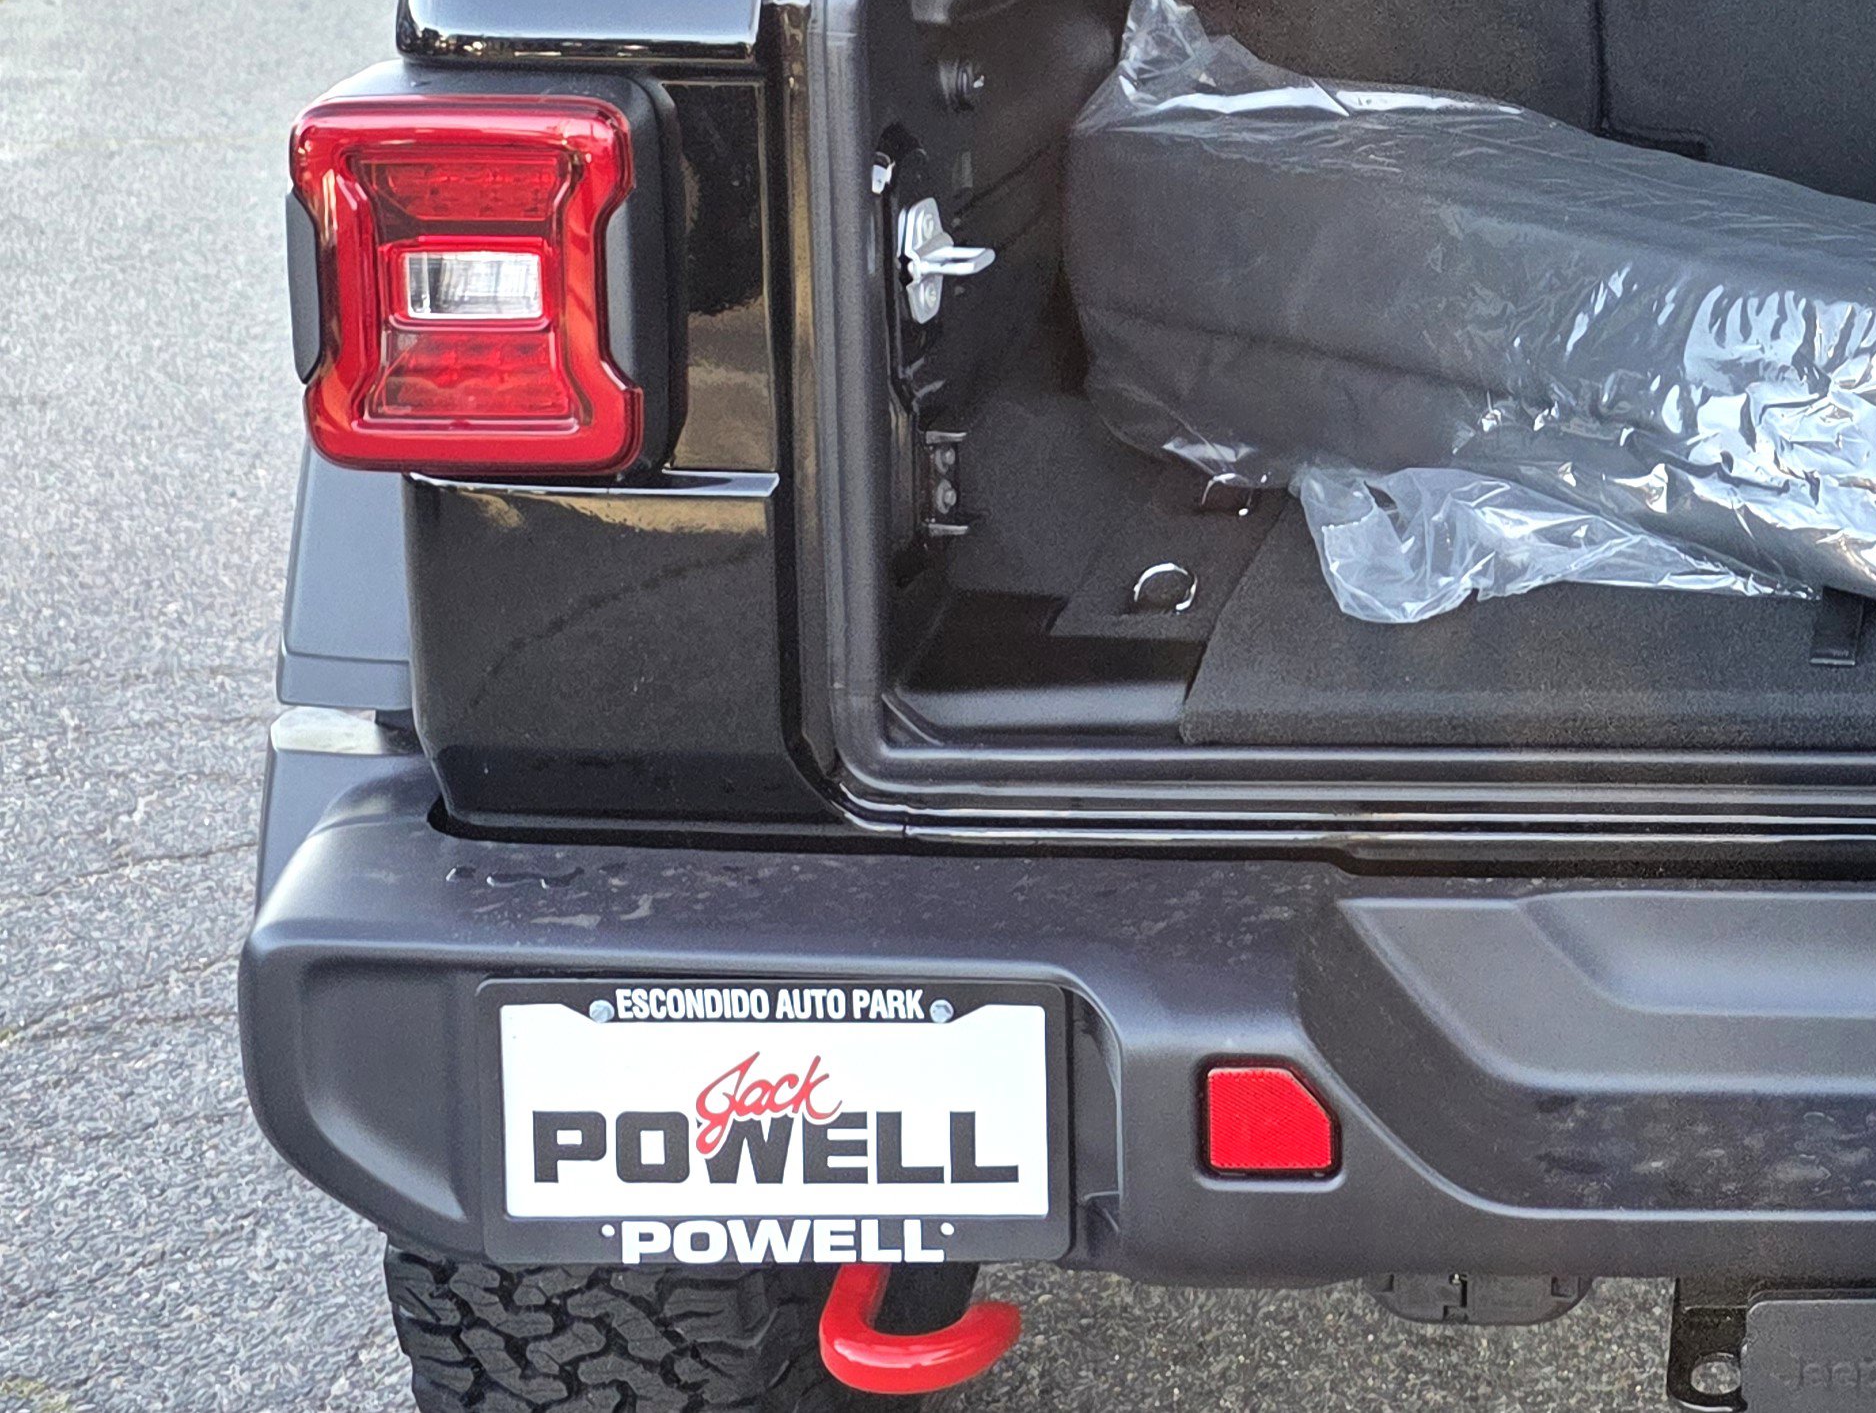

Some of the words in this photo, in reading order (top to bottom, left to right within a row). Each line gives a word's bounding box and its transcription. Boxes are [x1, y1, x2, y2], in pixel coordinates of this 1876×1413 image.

[616, 989, 769, 1020] ESCONDIDO
[776, 989, 845, 1020] AUTO
[852, 990, 924, 1019] PARK
[696, 1051, 843, 1154] Jack
[532, 1111, 1019, 1184] POWELL
[622, 1219, 944, 1264] POWELL
